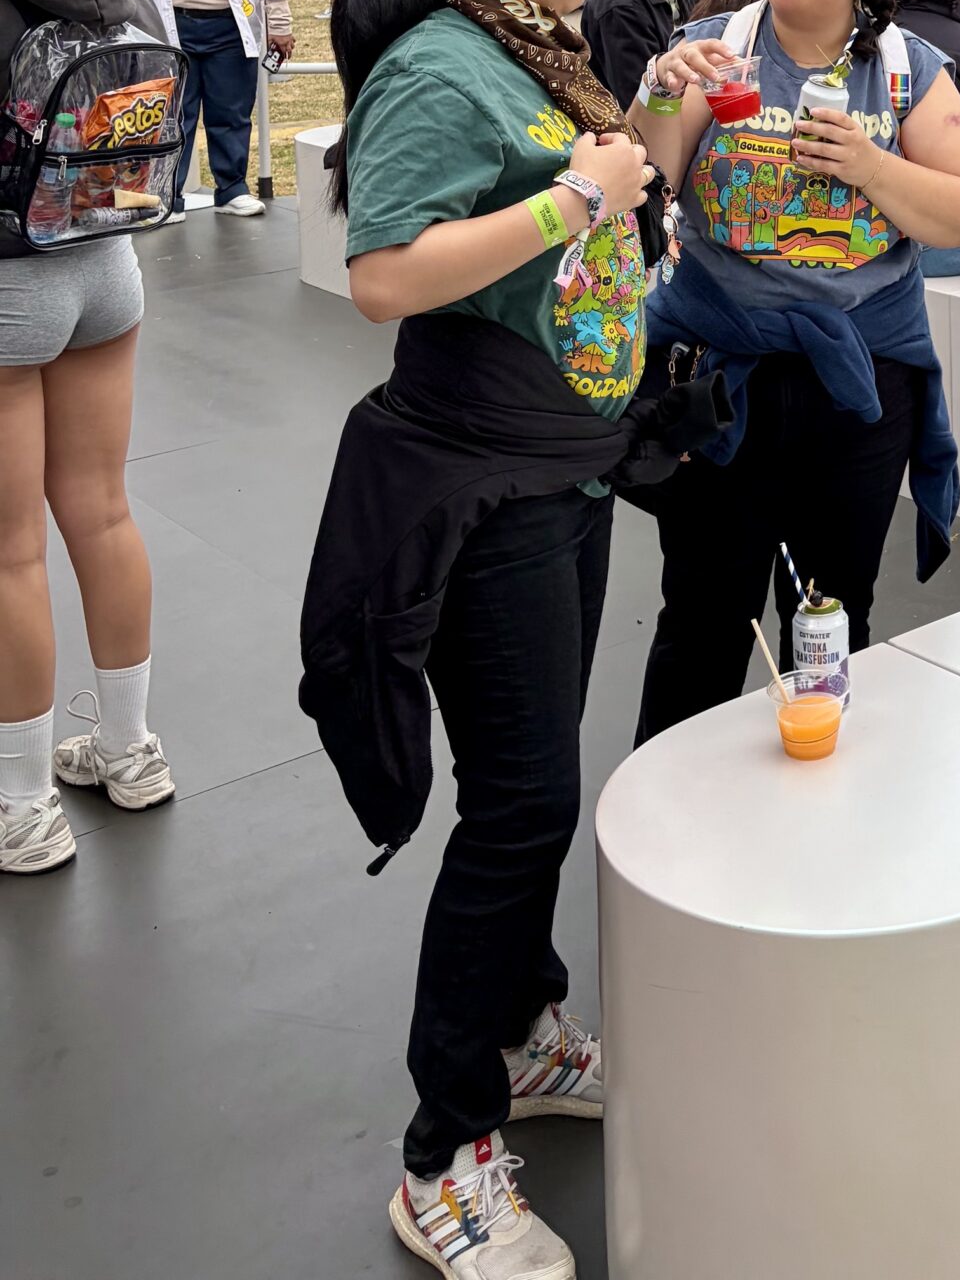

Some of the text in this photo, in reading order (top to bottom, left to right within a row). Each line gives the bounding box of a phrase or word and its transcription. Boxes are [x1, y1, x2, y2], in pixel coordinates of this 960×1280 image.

[851, 110, 893, 140] NDS
[739, 141, 775, 155] GOLDEN
[802, 641, 827, 654] VODKA
[795, 649, 840, 665] TRANSFUSION
